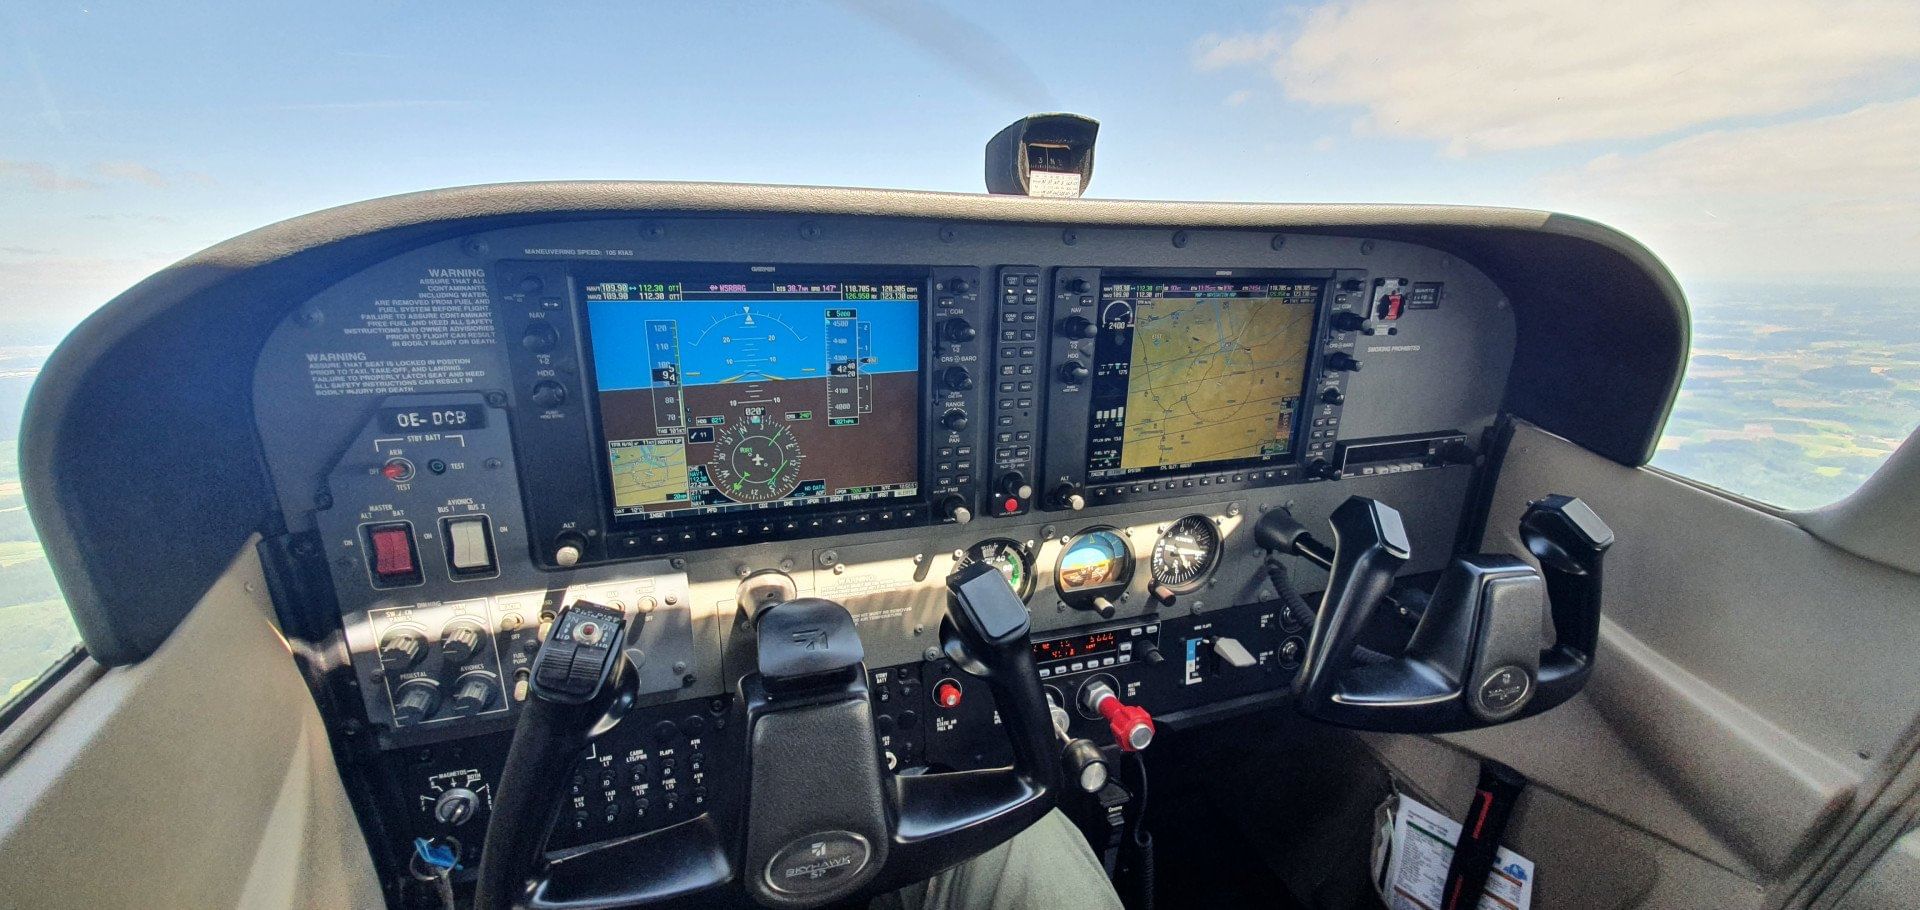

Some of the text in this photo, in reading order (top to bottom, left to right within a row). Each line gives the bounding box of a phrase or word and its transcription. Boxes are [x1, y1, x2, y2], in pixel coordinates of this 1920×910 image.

[428, 269, 485, 277] WARNING
[306, 352, 366, 362] WARNING
[448, 498, 473, 506] AVIONICS
[369, 504, 393, 512] MASTER
[438, 506, 450, 514] BUS
[511, 633, 521, 641] OFF
[513, 657, 527, 665] PUMP
[439, 769, 467, 779] MAGNETOS
[786, 856, 851, 878] SKYHAWK
